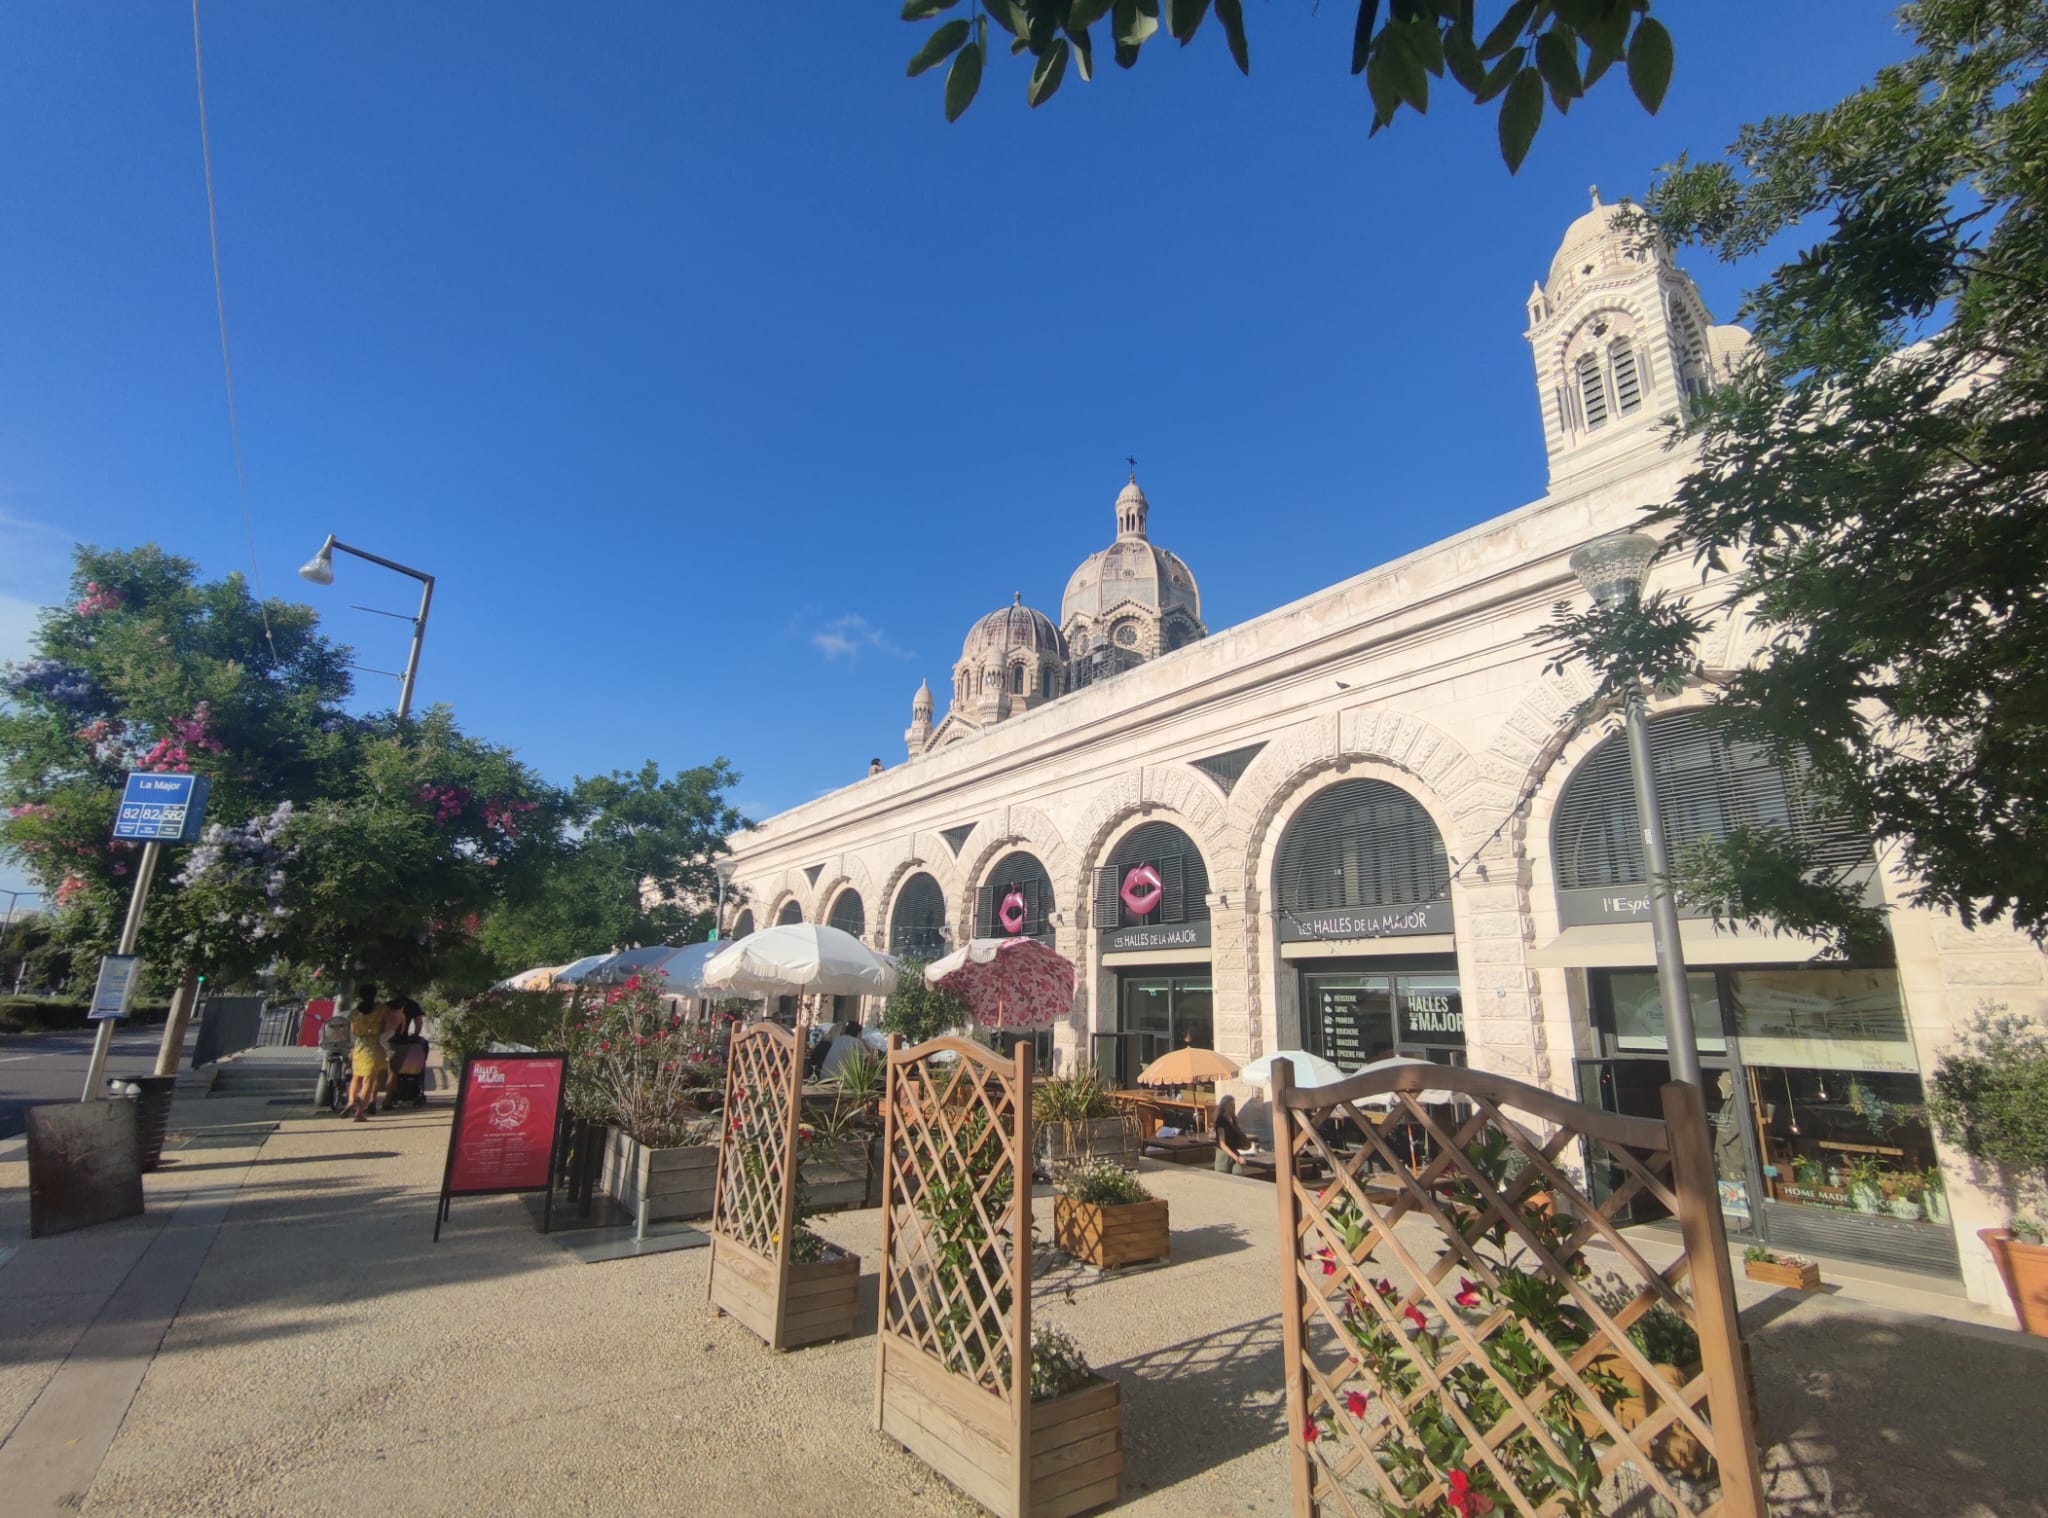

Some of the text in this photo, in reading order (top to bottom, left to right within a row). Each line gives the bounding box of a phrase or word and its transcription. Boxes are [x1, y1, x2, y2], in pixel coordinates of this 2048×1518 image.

[139, 780, 182, 792] La Major
[122, 808, 140, 819] 82
[163, 809, 185, 821] 582
[1313, 917, 1352, 934] HALLES
[1354, 919, 1366, 932] DE
[1367, 919, 1380, 931] LA
[1382, 912, 1428, 930] MAJOR
[1124, 933, 1149, 947] HALLES
[1150, 934, 1158, 945] DE
[1158, 934, 1168, 945] LA
[1167, 929, 1197, 944] MAJOR
[1408, 996, 1449, 1013] HALLES
[1418, 1012, 1464, 1033] MAJOR
[1784, 1186, 1816, 1198] HOME
